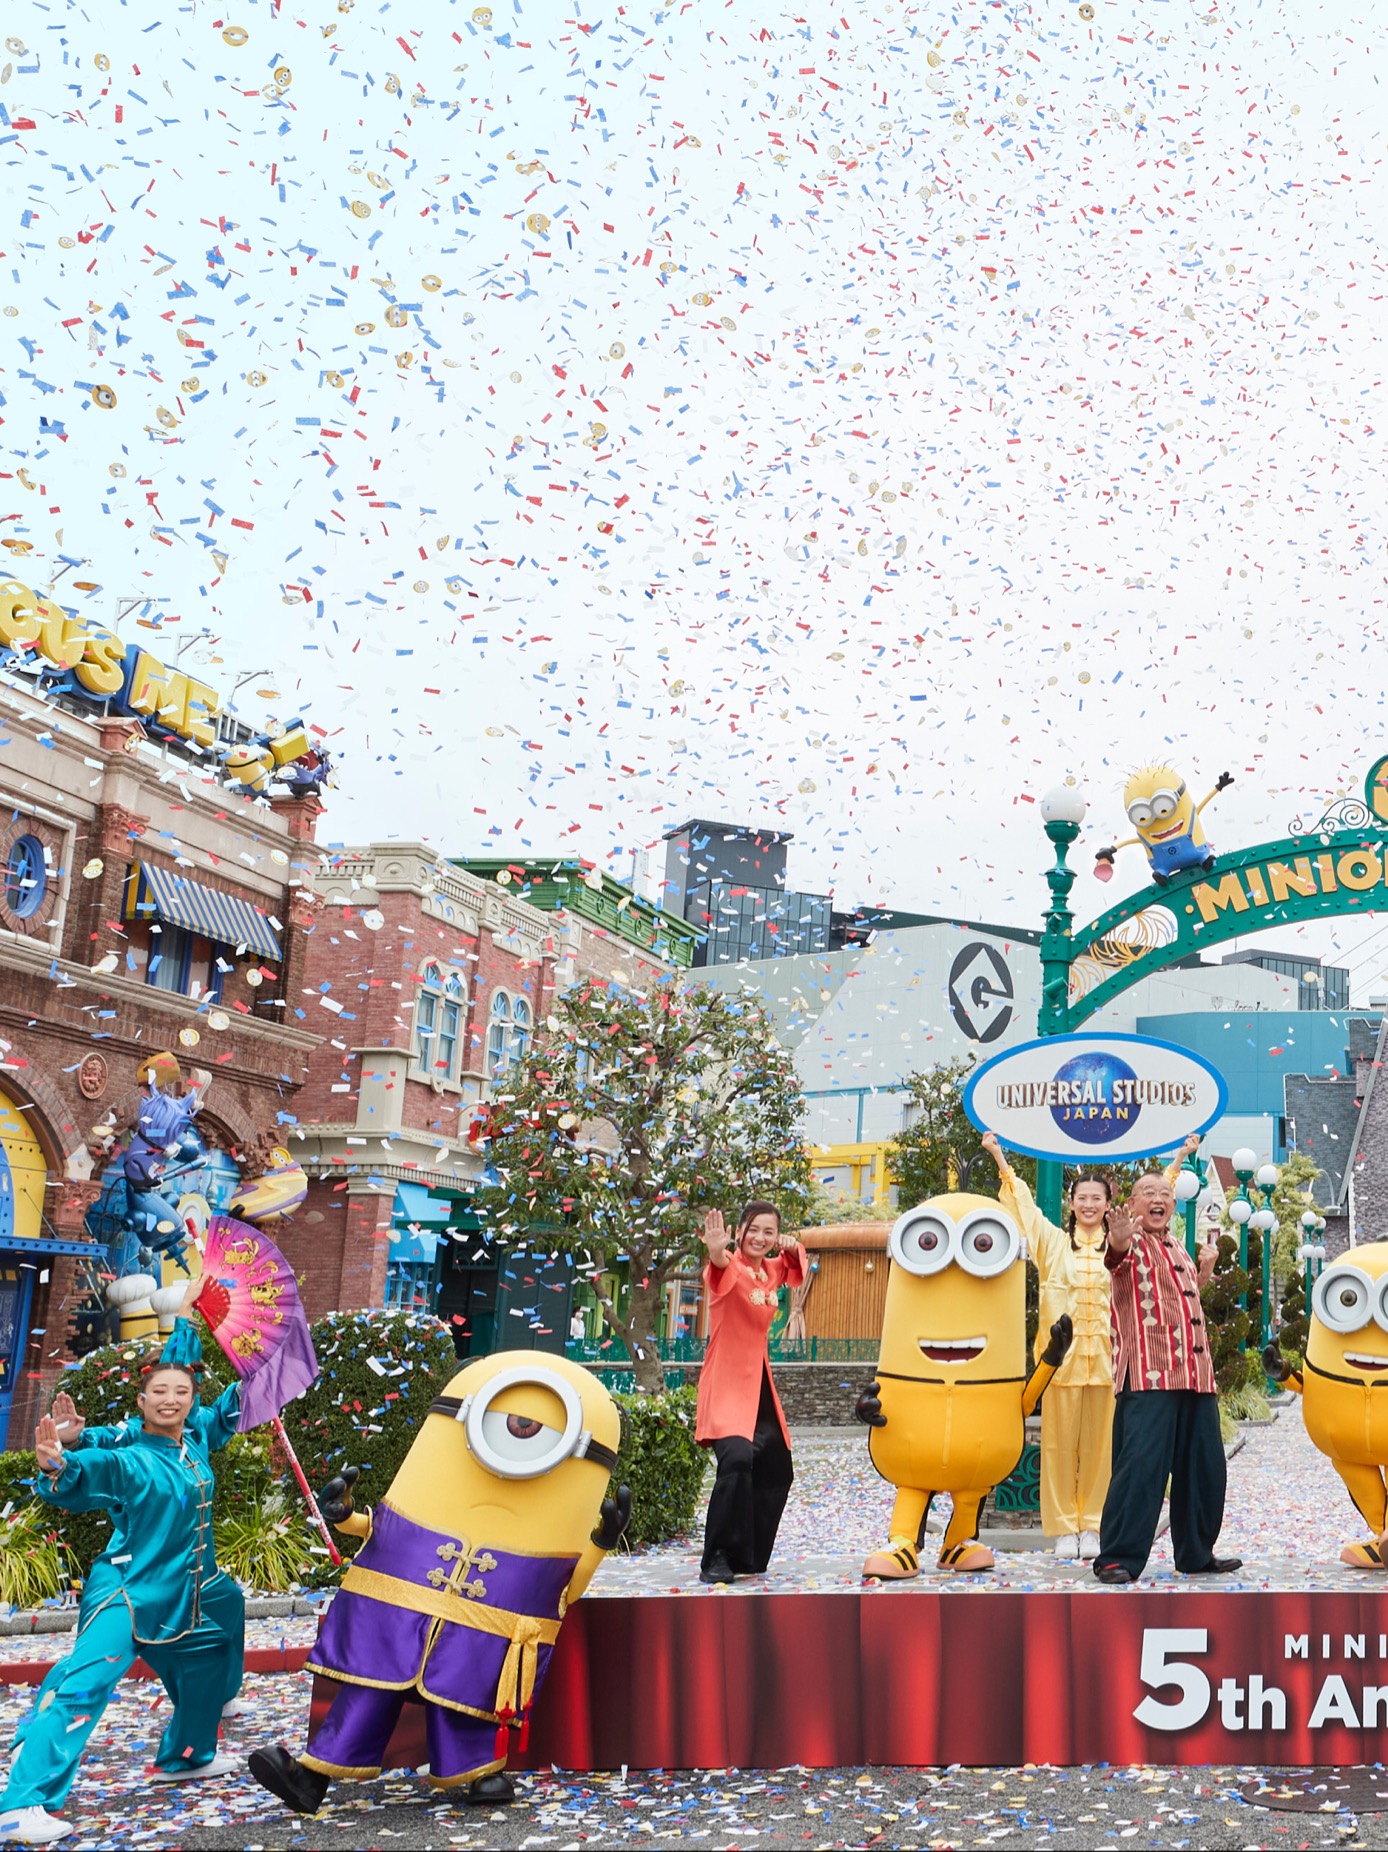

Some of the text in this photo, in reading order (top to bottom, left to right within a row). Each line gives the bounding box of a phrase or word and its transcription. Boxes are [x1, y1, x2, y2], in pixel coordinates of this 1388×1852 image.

[996, 1078, 1197, 1110] UNIVERSAL STUDIOS
[1062, 1106, 1130, 1122] JAPAN
[1131, 1627, 1287, 1732] 5th
